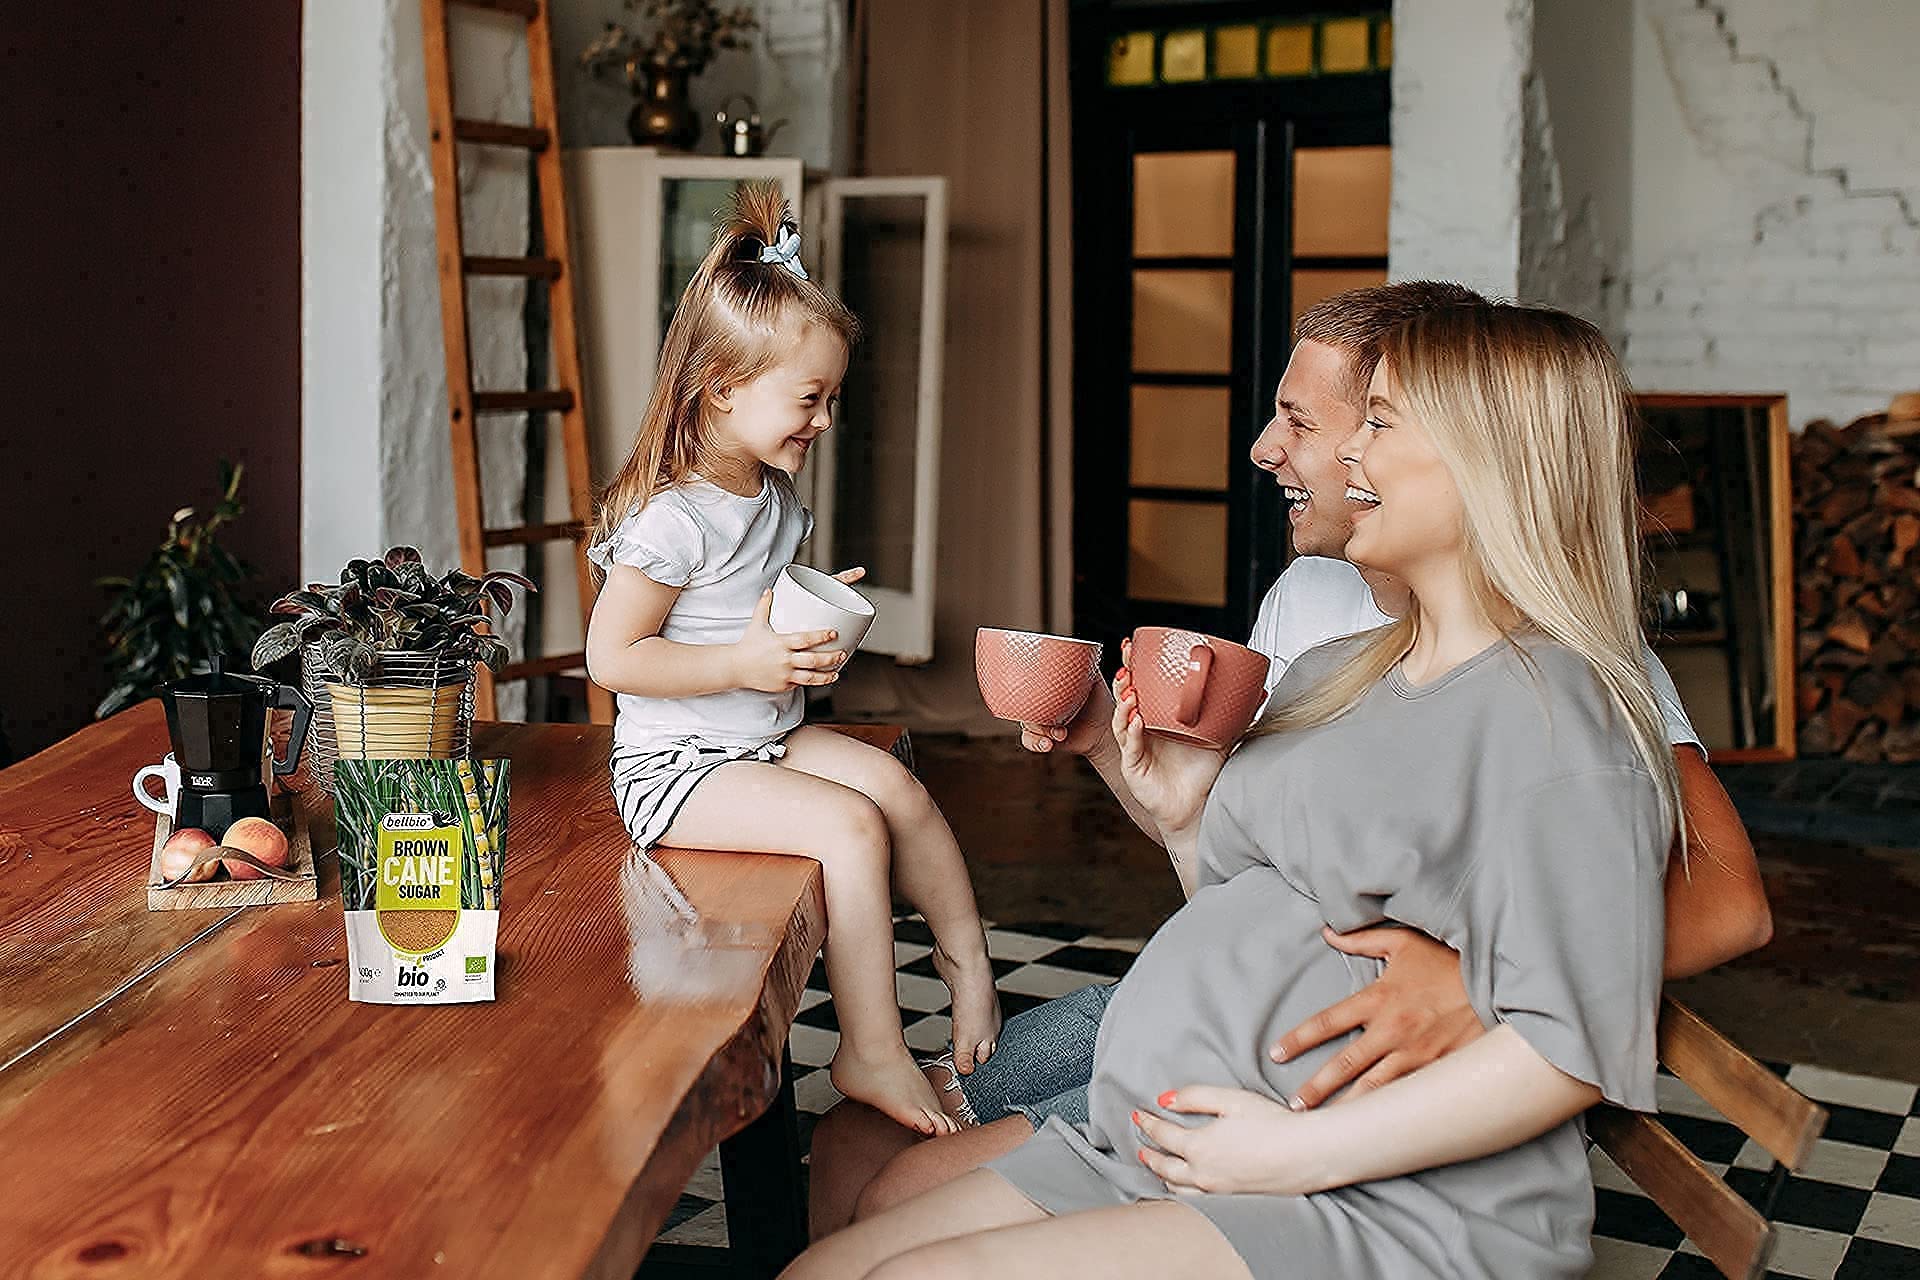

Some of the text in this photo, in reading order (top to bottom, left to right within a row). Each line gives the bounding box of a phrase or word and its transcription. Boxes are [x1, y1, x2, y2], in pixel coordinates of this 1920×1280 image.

[386, 815, 427, 827] bellbio
[394, 841, 449, 857] BROWN
[383, 856, 454, 886] CANE
[399, 885, 441, 899] SUGAR
[398, 966, 429, 986] bio
